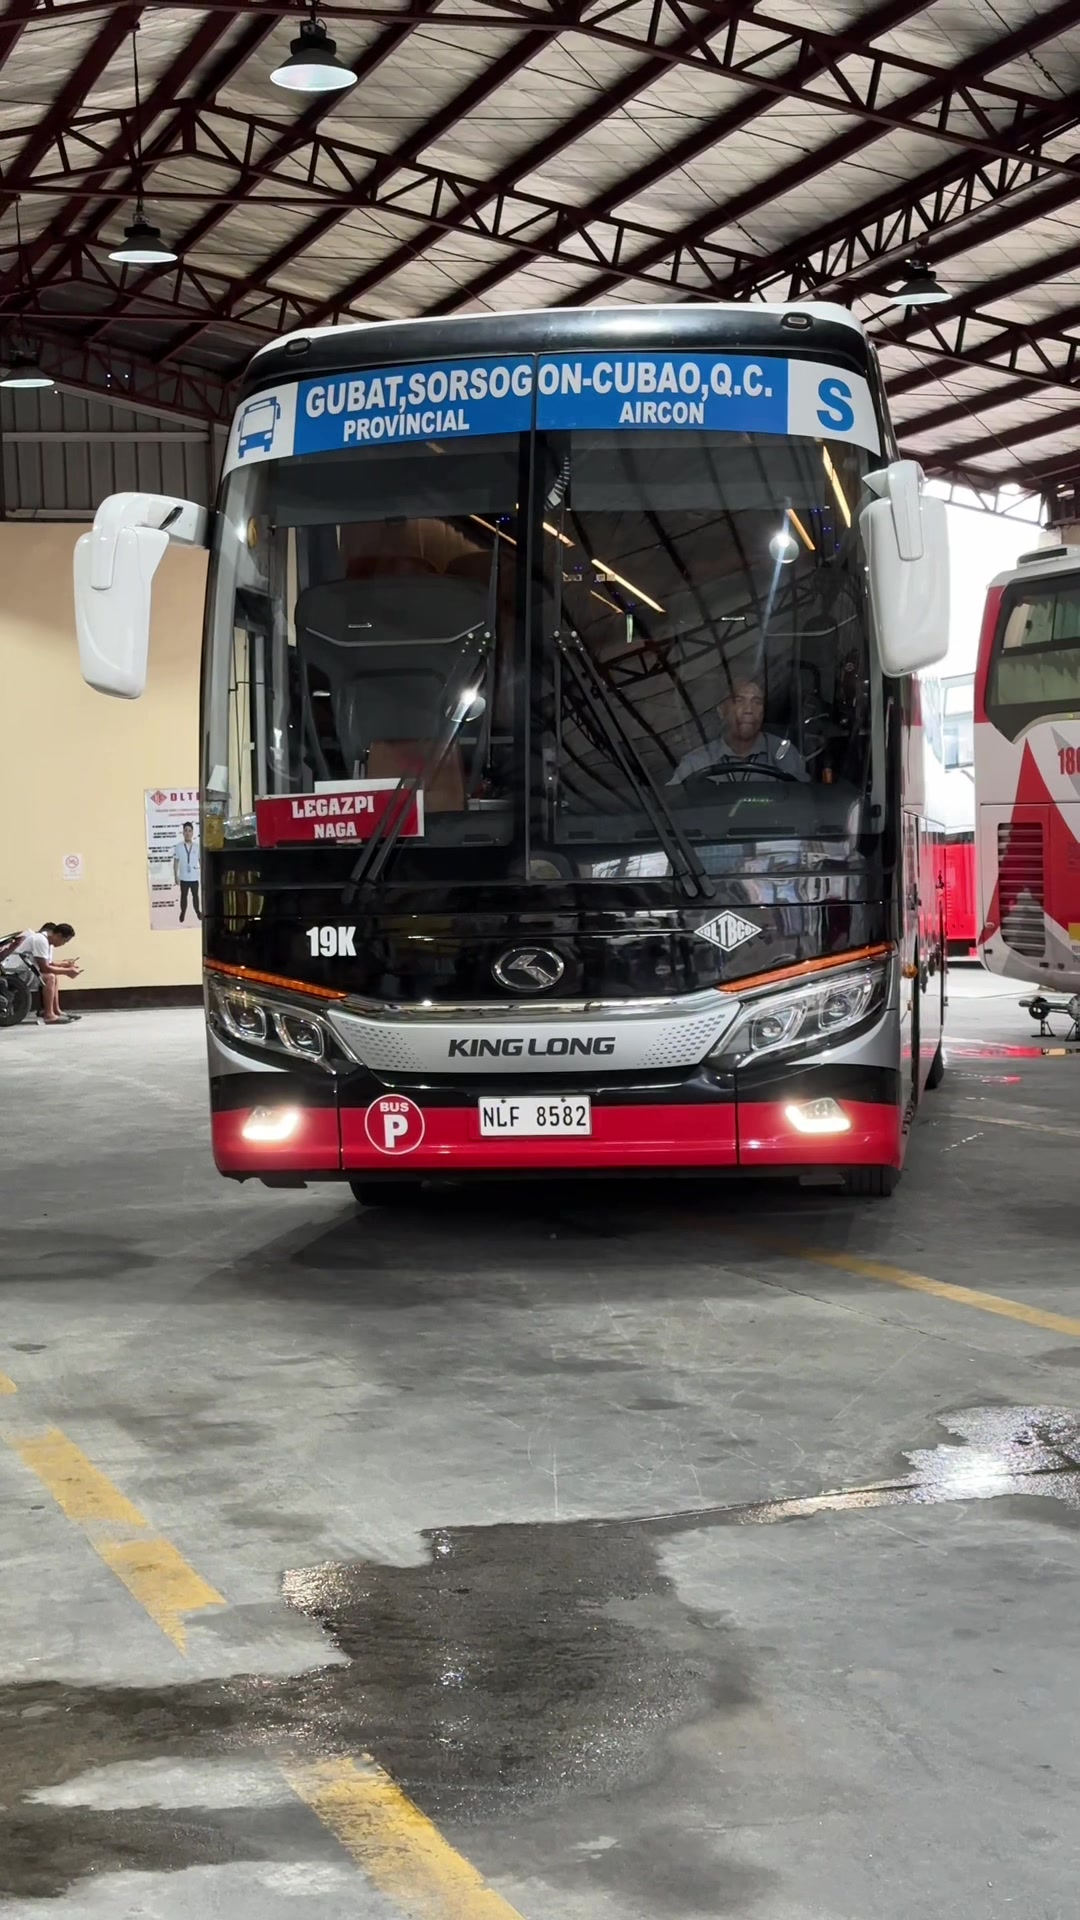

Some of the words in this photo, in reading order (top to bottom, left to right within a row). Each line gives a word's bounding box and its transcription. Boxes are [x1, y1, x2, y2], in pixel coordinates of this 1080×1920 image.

[619, 401, 705, 424] AIRCON
[816, 378, 855, 432] S
[343, 408, 470, 442] PROVINCIAL
[291, 795, 375, 818] LEGAZPI
[313, 821, 358, 839] NAGA
[305, 926, 357, 956] 19K
[447, 1038, 524, 1058] KING
[527, 1036, 616, 1057] LONG
[380, 1101, 409, 1112] BUS
[483, 1106, 520, 1127] NLF
[536, 1105, 587, 1127] 8582
[383, 1114, 409, 1148] P
